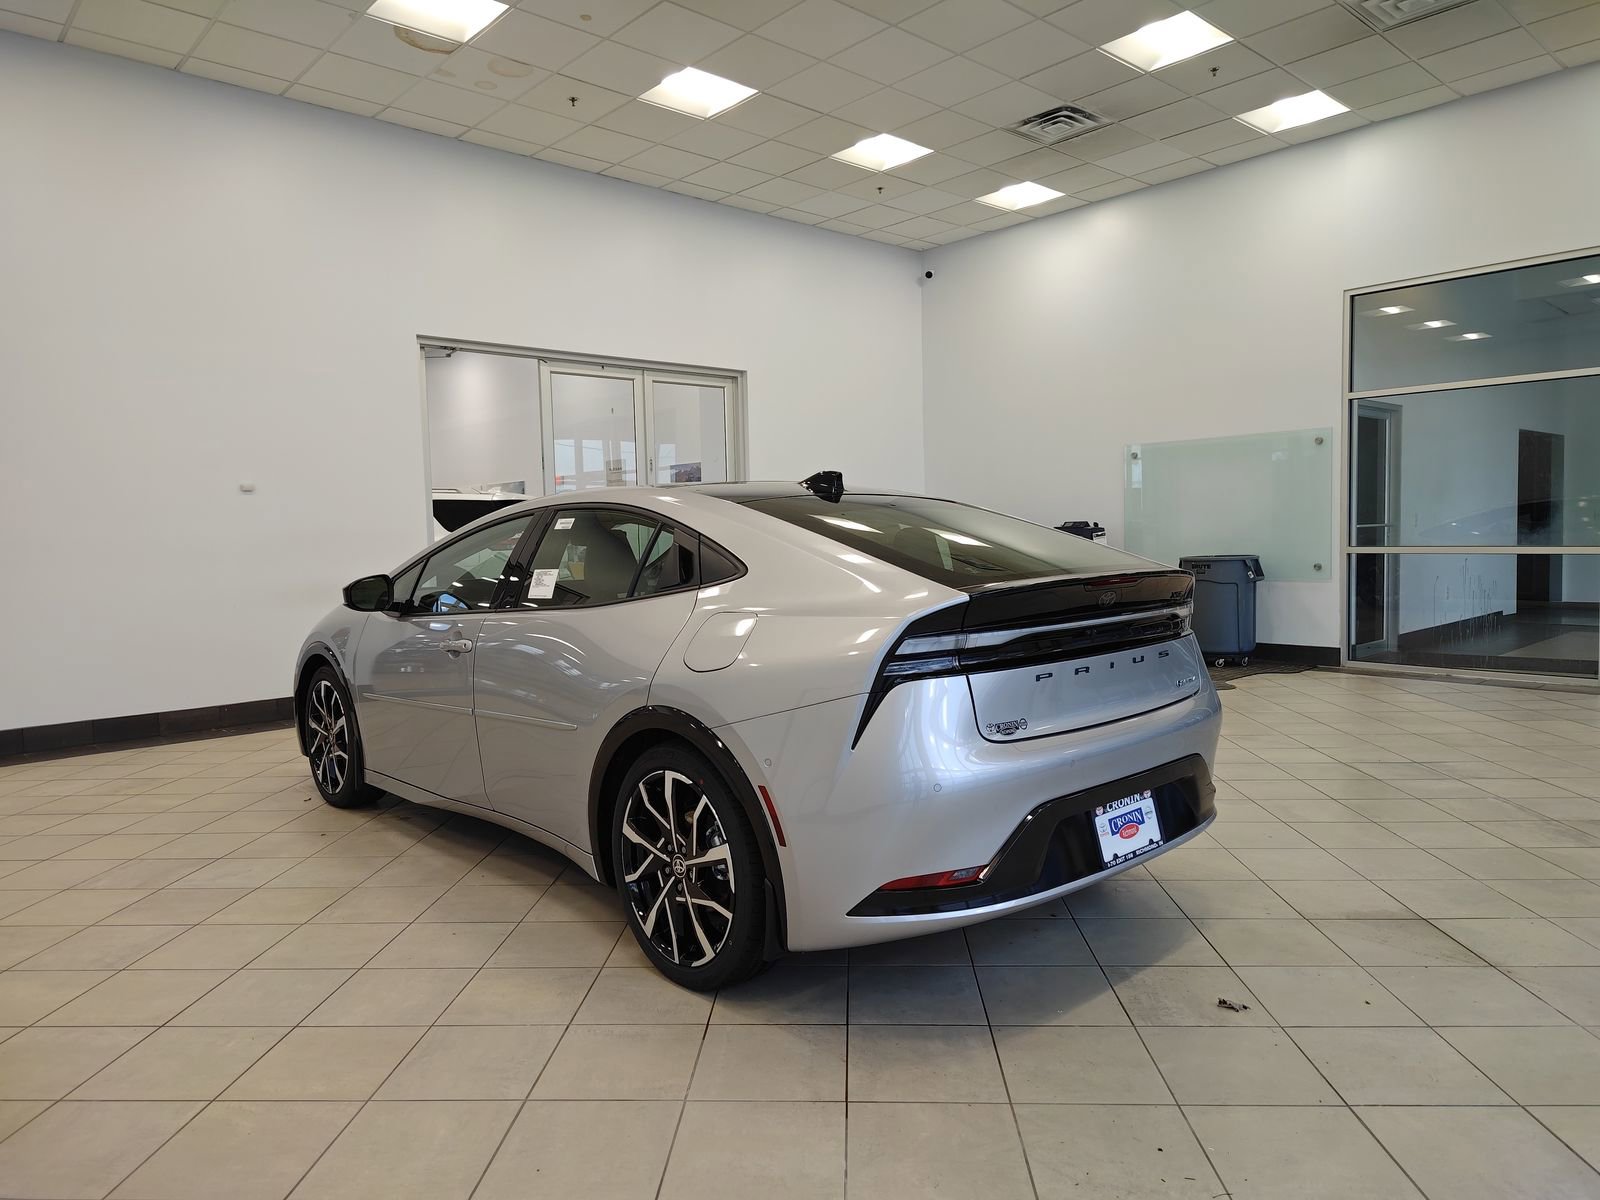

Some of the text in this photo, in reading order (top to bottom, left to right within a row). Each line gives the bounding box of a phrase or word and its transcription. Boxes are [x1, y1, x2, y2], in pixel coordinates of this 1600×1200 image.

[1035, 650, 1169, 682] PRIUS
[1106, 793, 1140, 812] CRONIN
[1111, 810, 1143, 832] CRONIN
